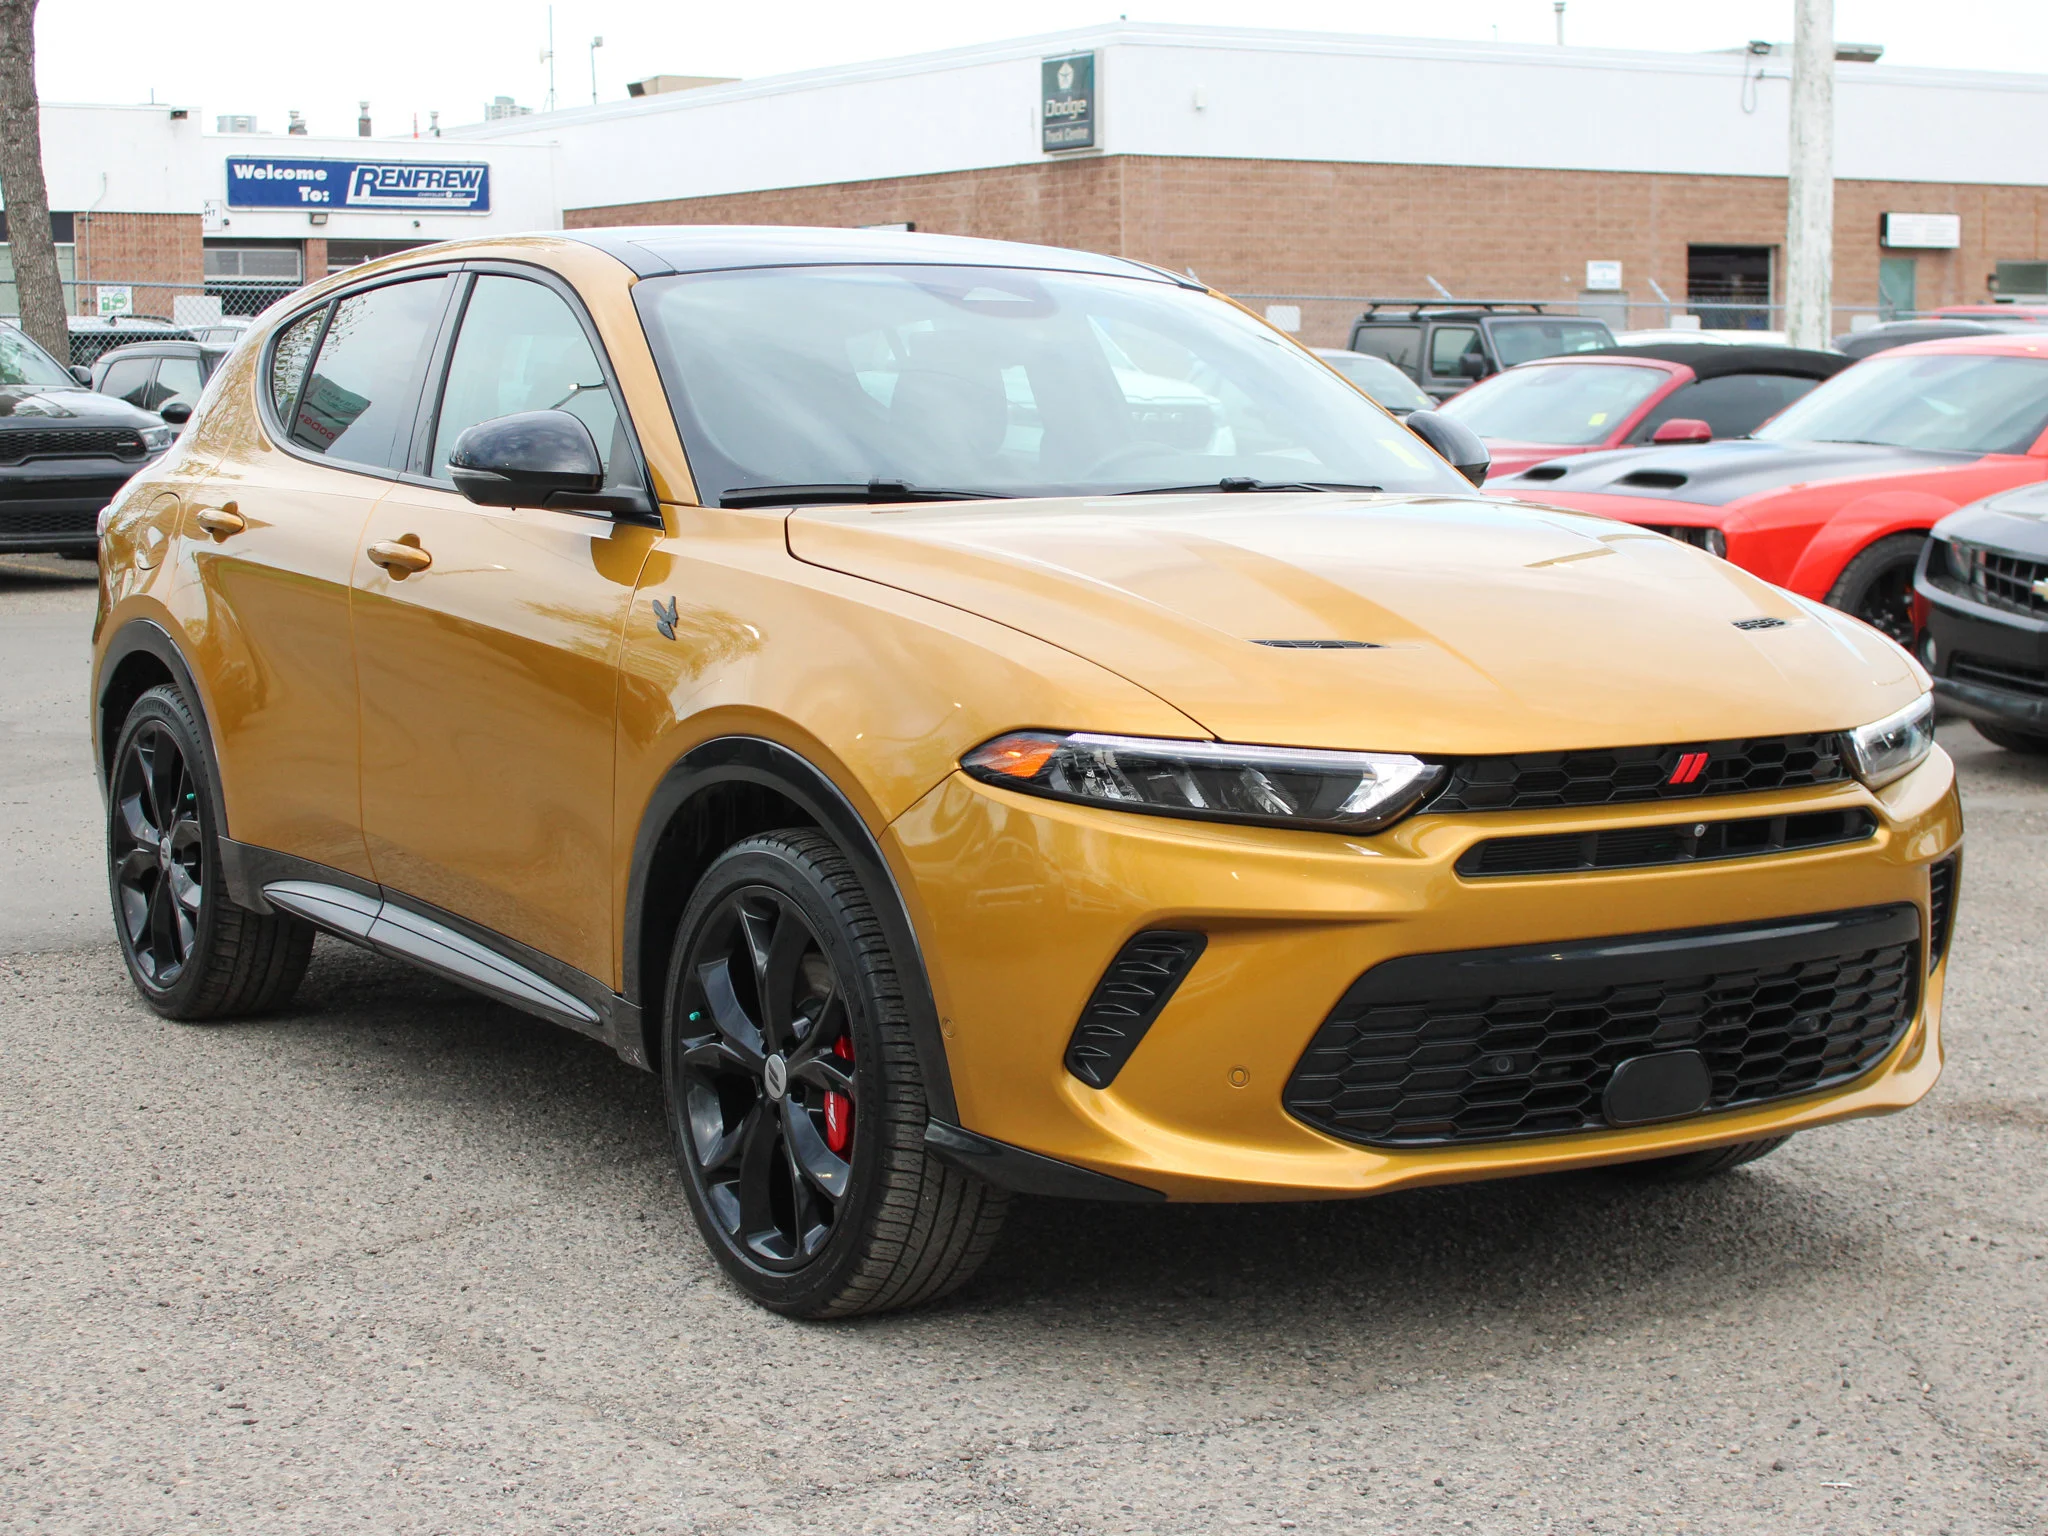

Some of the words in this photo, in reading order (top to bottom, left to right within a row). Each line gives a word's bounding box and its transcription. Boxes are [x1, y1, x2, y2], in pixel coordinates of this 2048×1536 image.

[1045, 96, 1087, 119] Dodge
[232, 164, 328, 181] Welcome
[352, 165, 483, 197] RENFREW
[299, 186, 330, 203] To:
